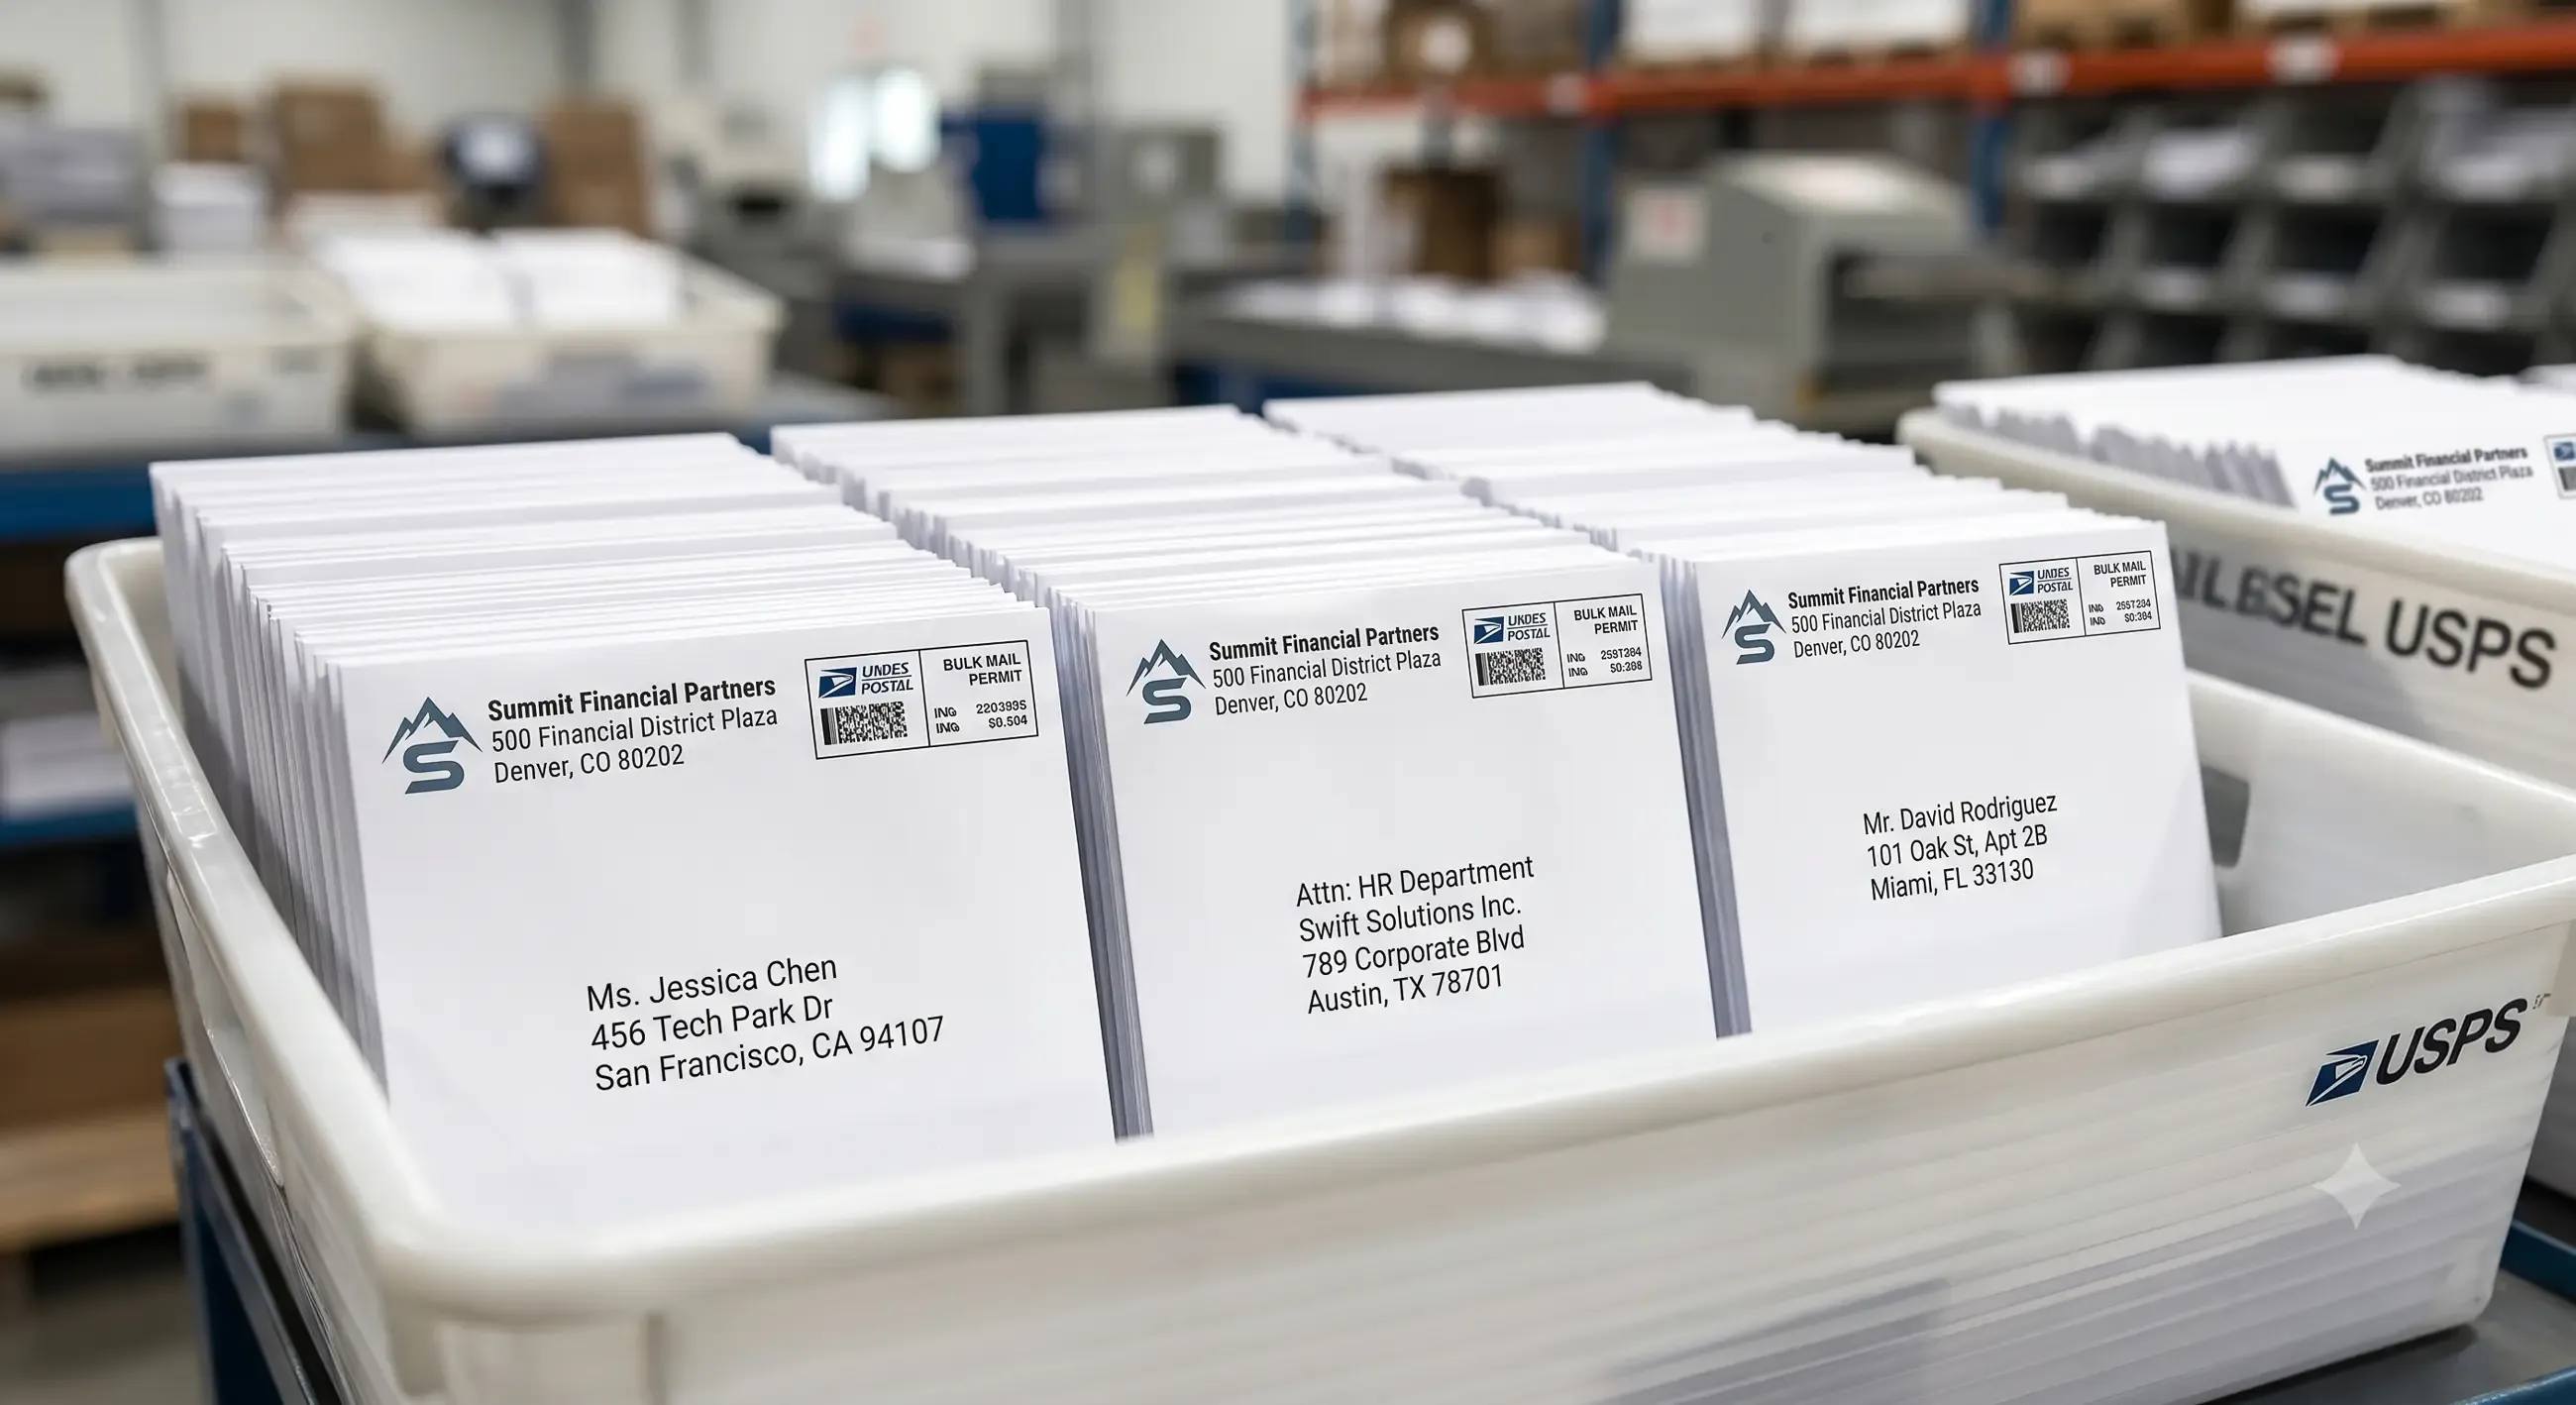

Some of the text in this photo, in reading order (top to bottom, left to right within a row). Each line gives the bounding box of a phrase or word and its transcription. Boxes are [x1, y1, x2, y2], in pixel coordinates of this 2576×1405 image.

[2365, 448, 2527, 473] Summit Financial Partners
[2371, 465, 2533, 491] 500 Financial District Plaza
[2376, 494, 2420, 510] Denver,
[2423, 492, 2441, 506] CO
[2094, 561, 2146, 575] BULK MAIL
[2110, 575, 2146, 587] PERMIT
[1788, 580, 1979, 608] Summit Financial Partners
[1574, 605, 1637, 620] BULK MAIL
[1594, 620, 1638, 634] PERMIT
[1792, 600, 1982, 633] 500 Financial District Plaza
[1210, 626, 1439, 661] Summit Financial Partners
[1508, 628, 1550, 641] POSTAL
[1794, 630, 1920, 658] Denver, CO 80202
[2385, 598, 2557, 691] USPS
[943, 653, 1020, 671] BULK MAIL
[969, 670, 1021, 686] PERMIT
[1214, 650, 1441, 688] 500 Financial District Plaza
[488, 680, 775, 721] Summit Financial Partners
[862, 680, 913, 695] POSTAL
[1216, 683, 1367, 715] Denver, CO 80202
[493, 707, 777, 752] 500 Financial District Plaza
[495, 744, 684, 783] Denver, CO 80202
[1864, 796, 2057, 834] Mr. David Rodriguez
[1868, 824, 2047, 867] 101 Oak St, Apt 2B
[1297, 856, 1534, 907] Attn: HR Department
[1872, 858, 2033, 900] Miami, FL 33130
[1300, 896, 1521, 941] Swift Solutions Inc.
[1303, 924, 1524, 978] 789 Corporate Blvd
[588, 958, 836, 1011] Ms. Jessica Chen
[1308, 964, 1501, 1014] Austin, TX 78701
[591, 996, 832, 1050] 456 Tech Park Dr
[596, 1016, 943, 1090] San Francisco, CA 94107
[2376, 998, 2528, 1085] USPS
